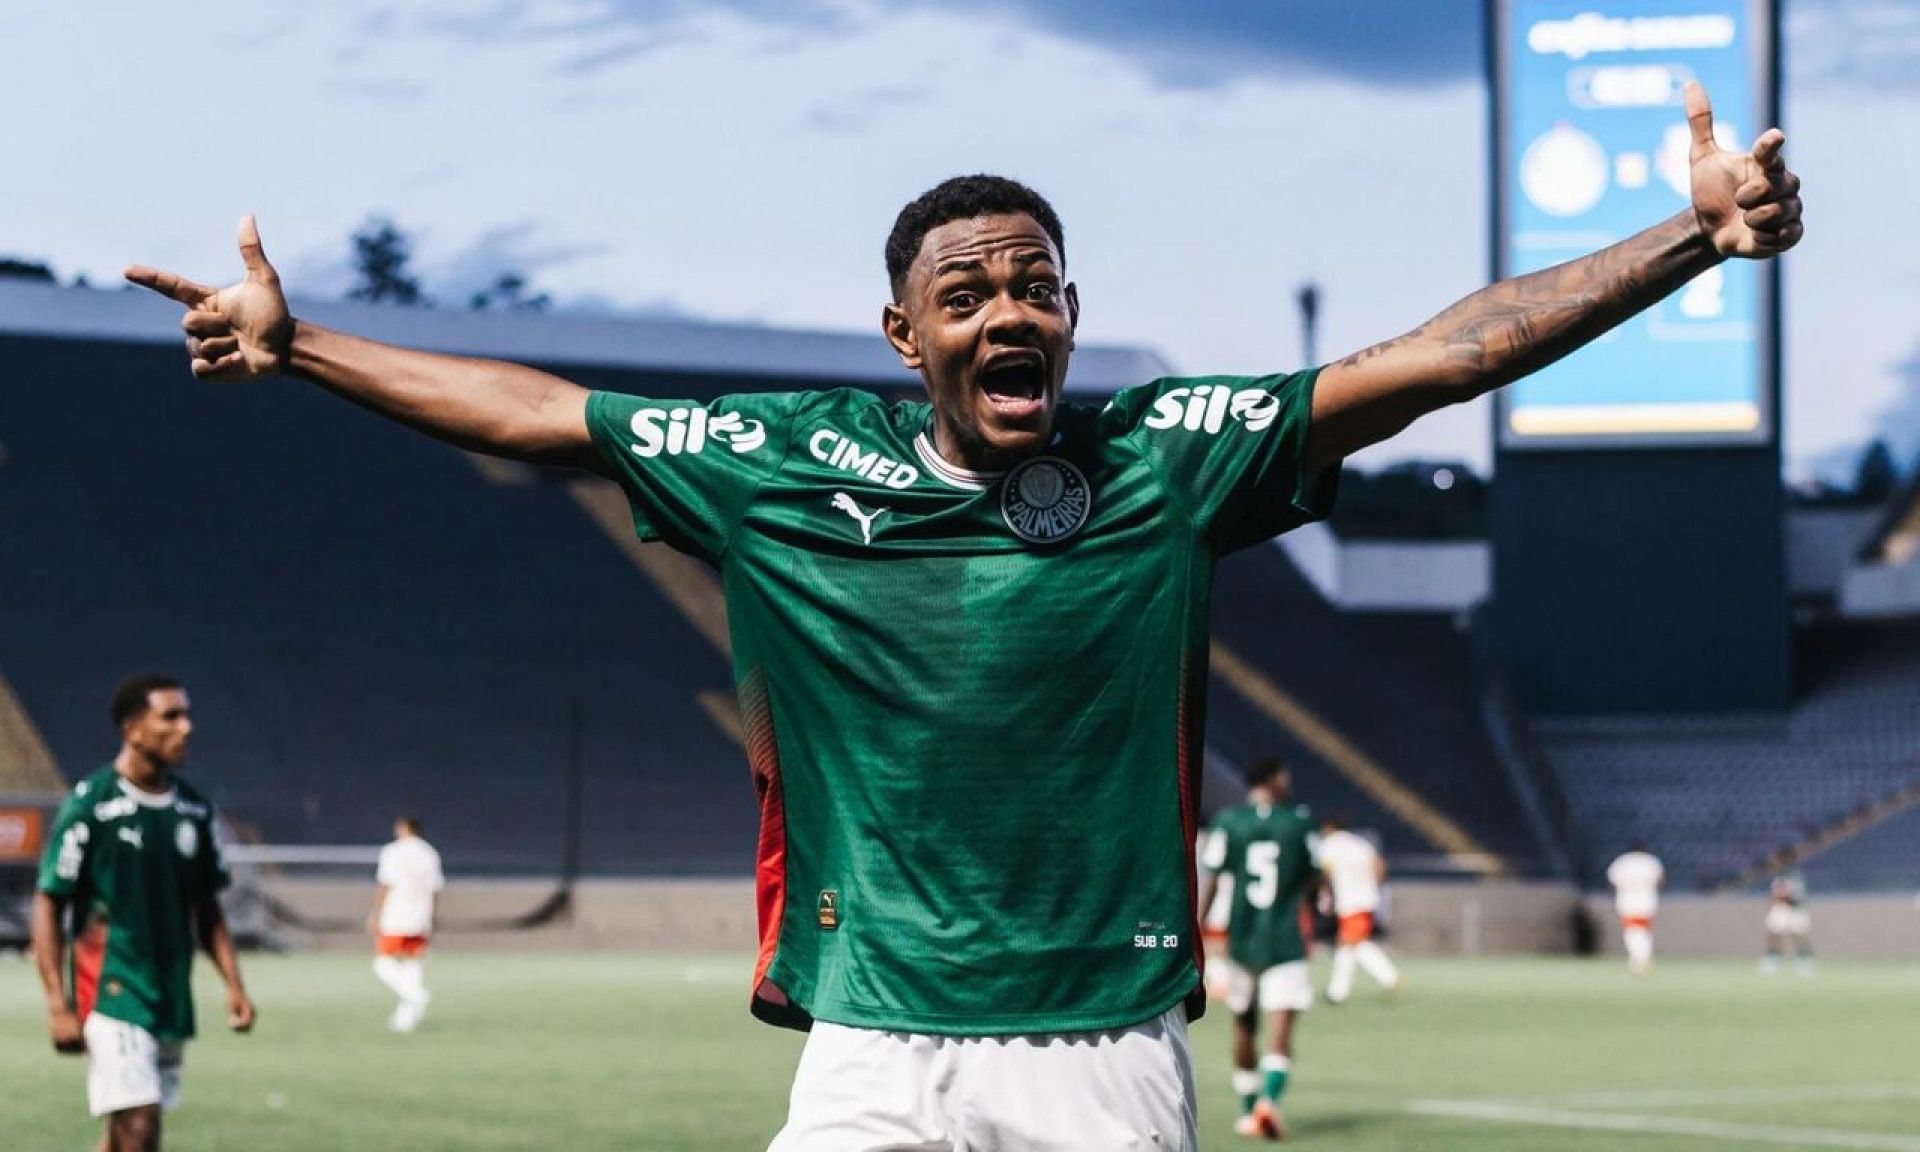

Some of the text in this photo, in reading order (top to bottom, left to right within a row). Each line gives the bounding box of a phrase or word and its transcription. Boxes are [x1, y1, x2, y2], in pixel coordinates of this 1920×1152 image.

[809, 428, 919, 489] CIMED
[1008, 487, 1084, 537] PALMEIRAS
[1246, 841, 1280, 909] 5
[1133, 935, 1178, 948] SUB 20
